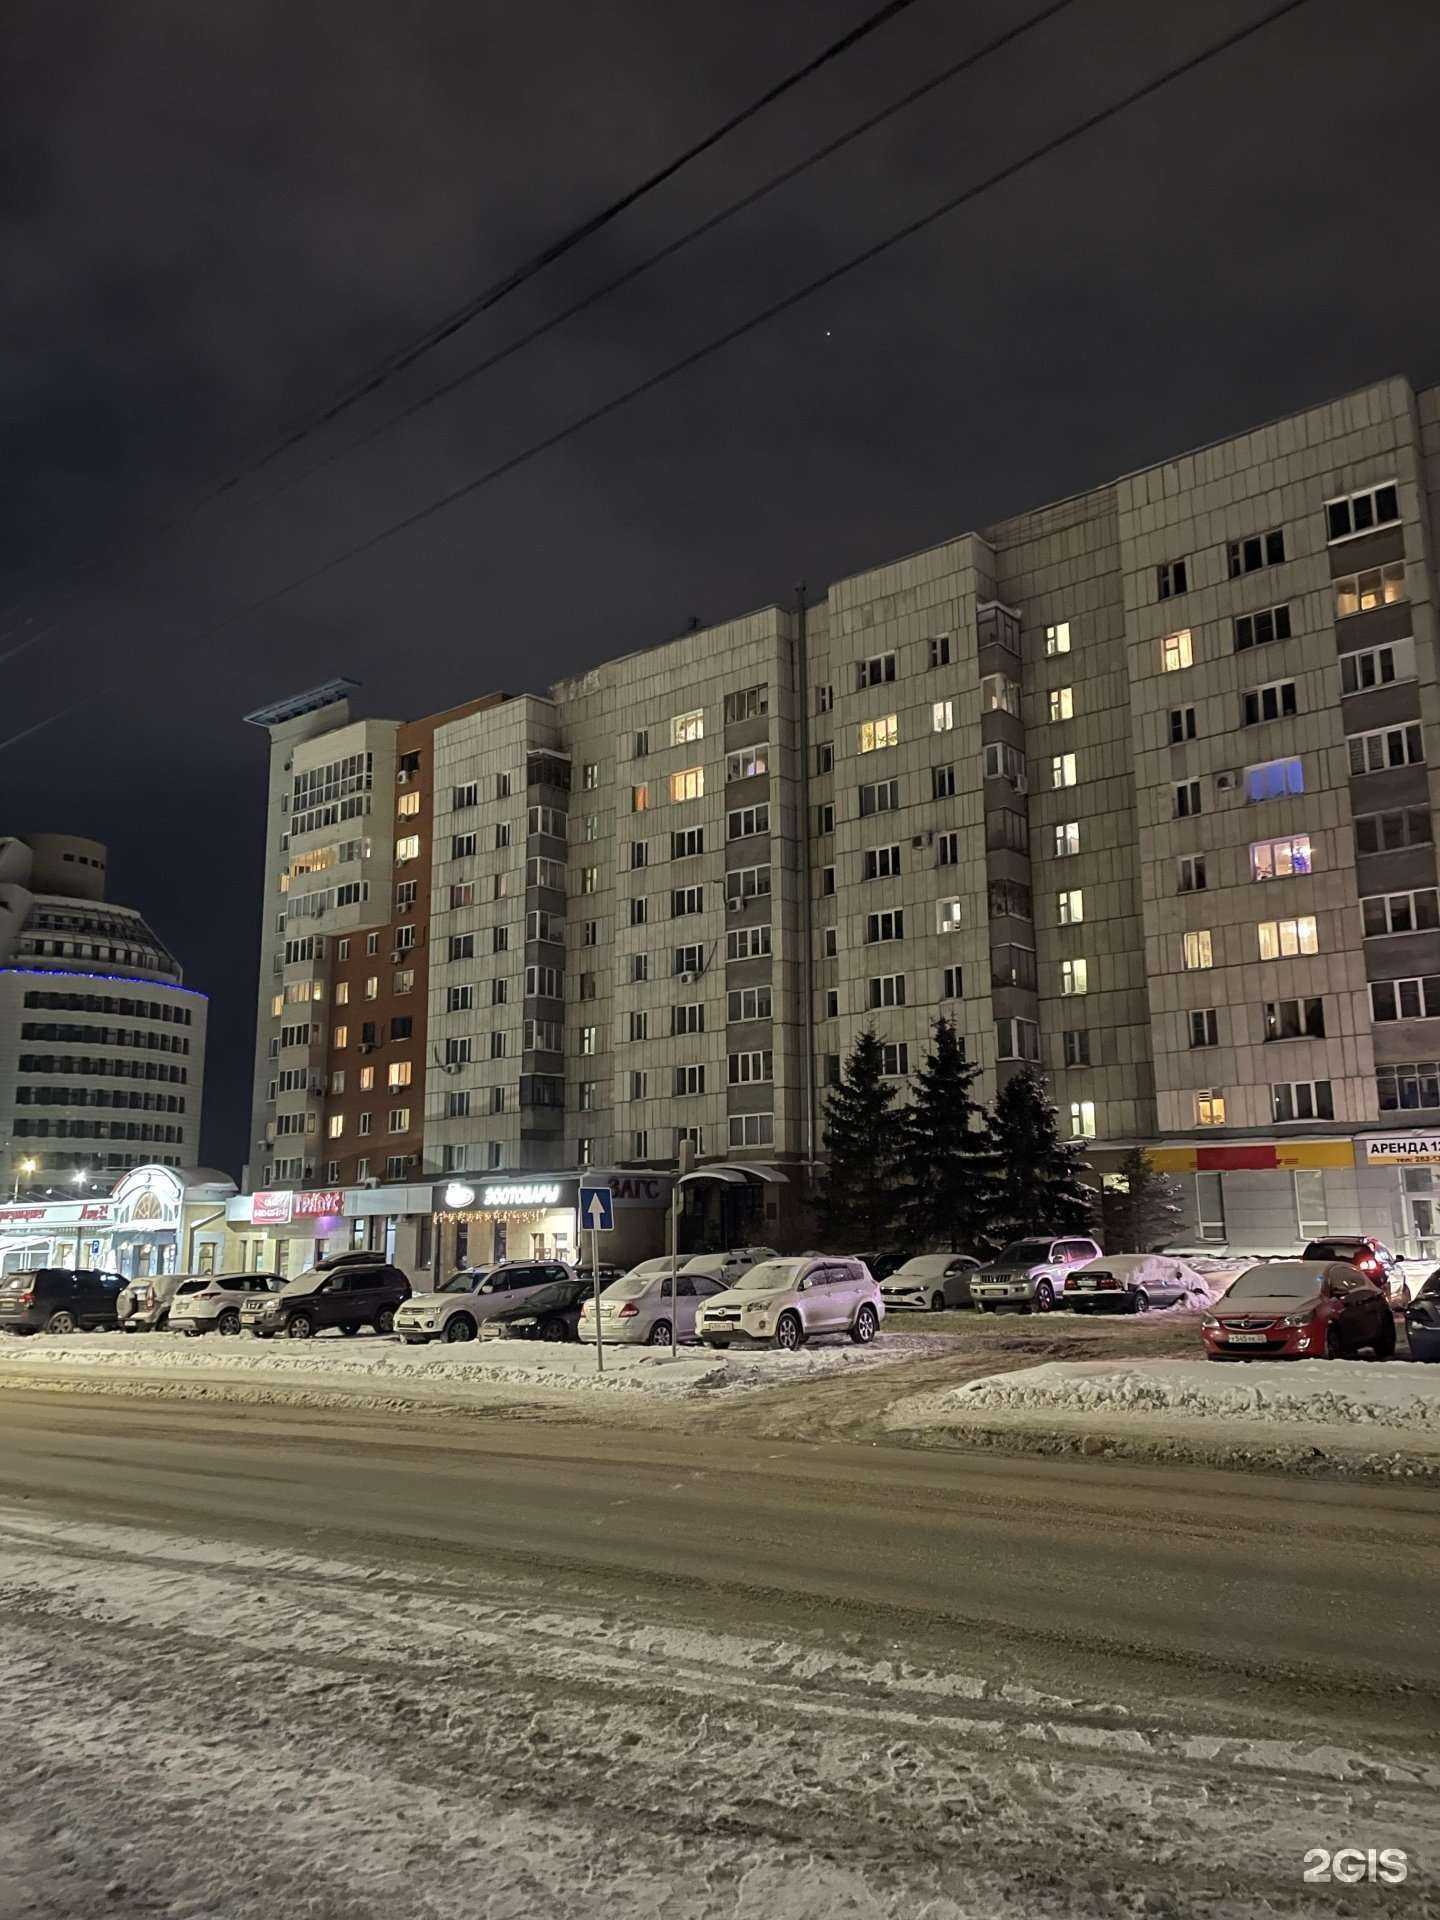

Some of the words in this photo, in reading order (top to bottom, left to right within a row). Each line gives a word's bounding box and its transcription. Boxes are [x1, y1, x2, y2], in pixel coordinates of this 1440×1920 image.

[1371, 1142, 1429, 1155] АРЕНДА
[1431, 1141, 1440, 1152] 1
[609, 1176, 660, 1199] ЗАГС
